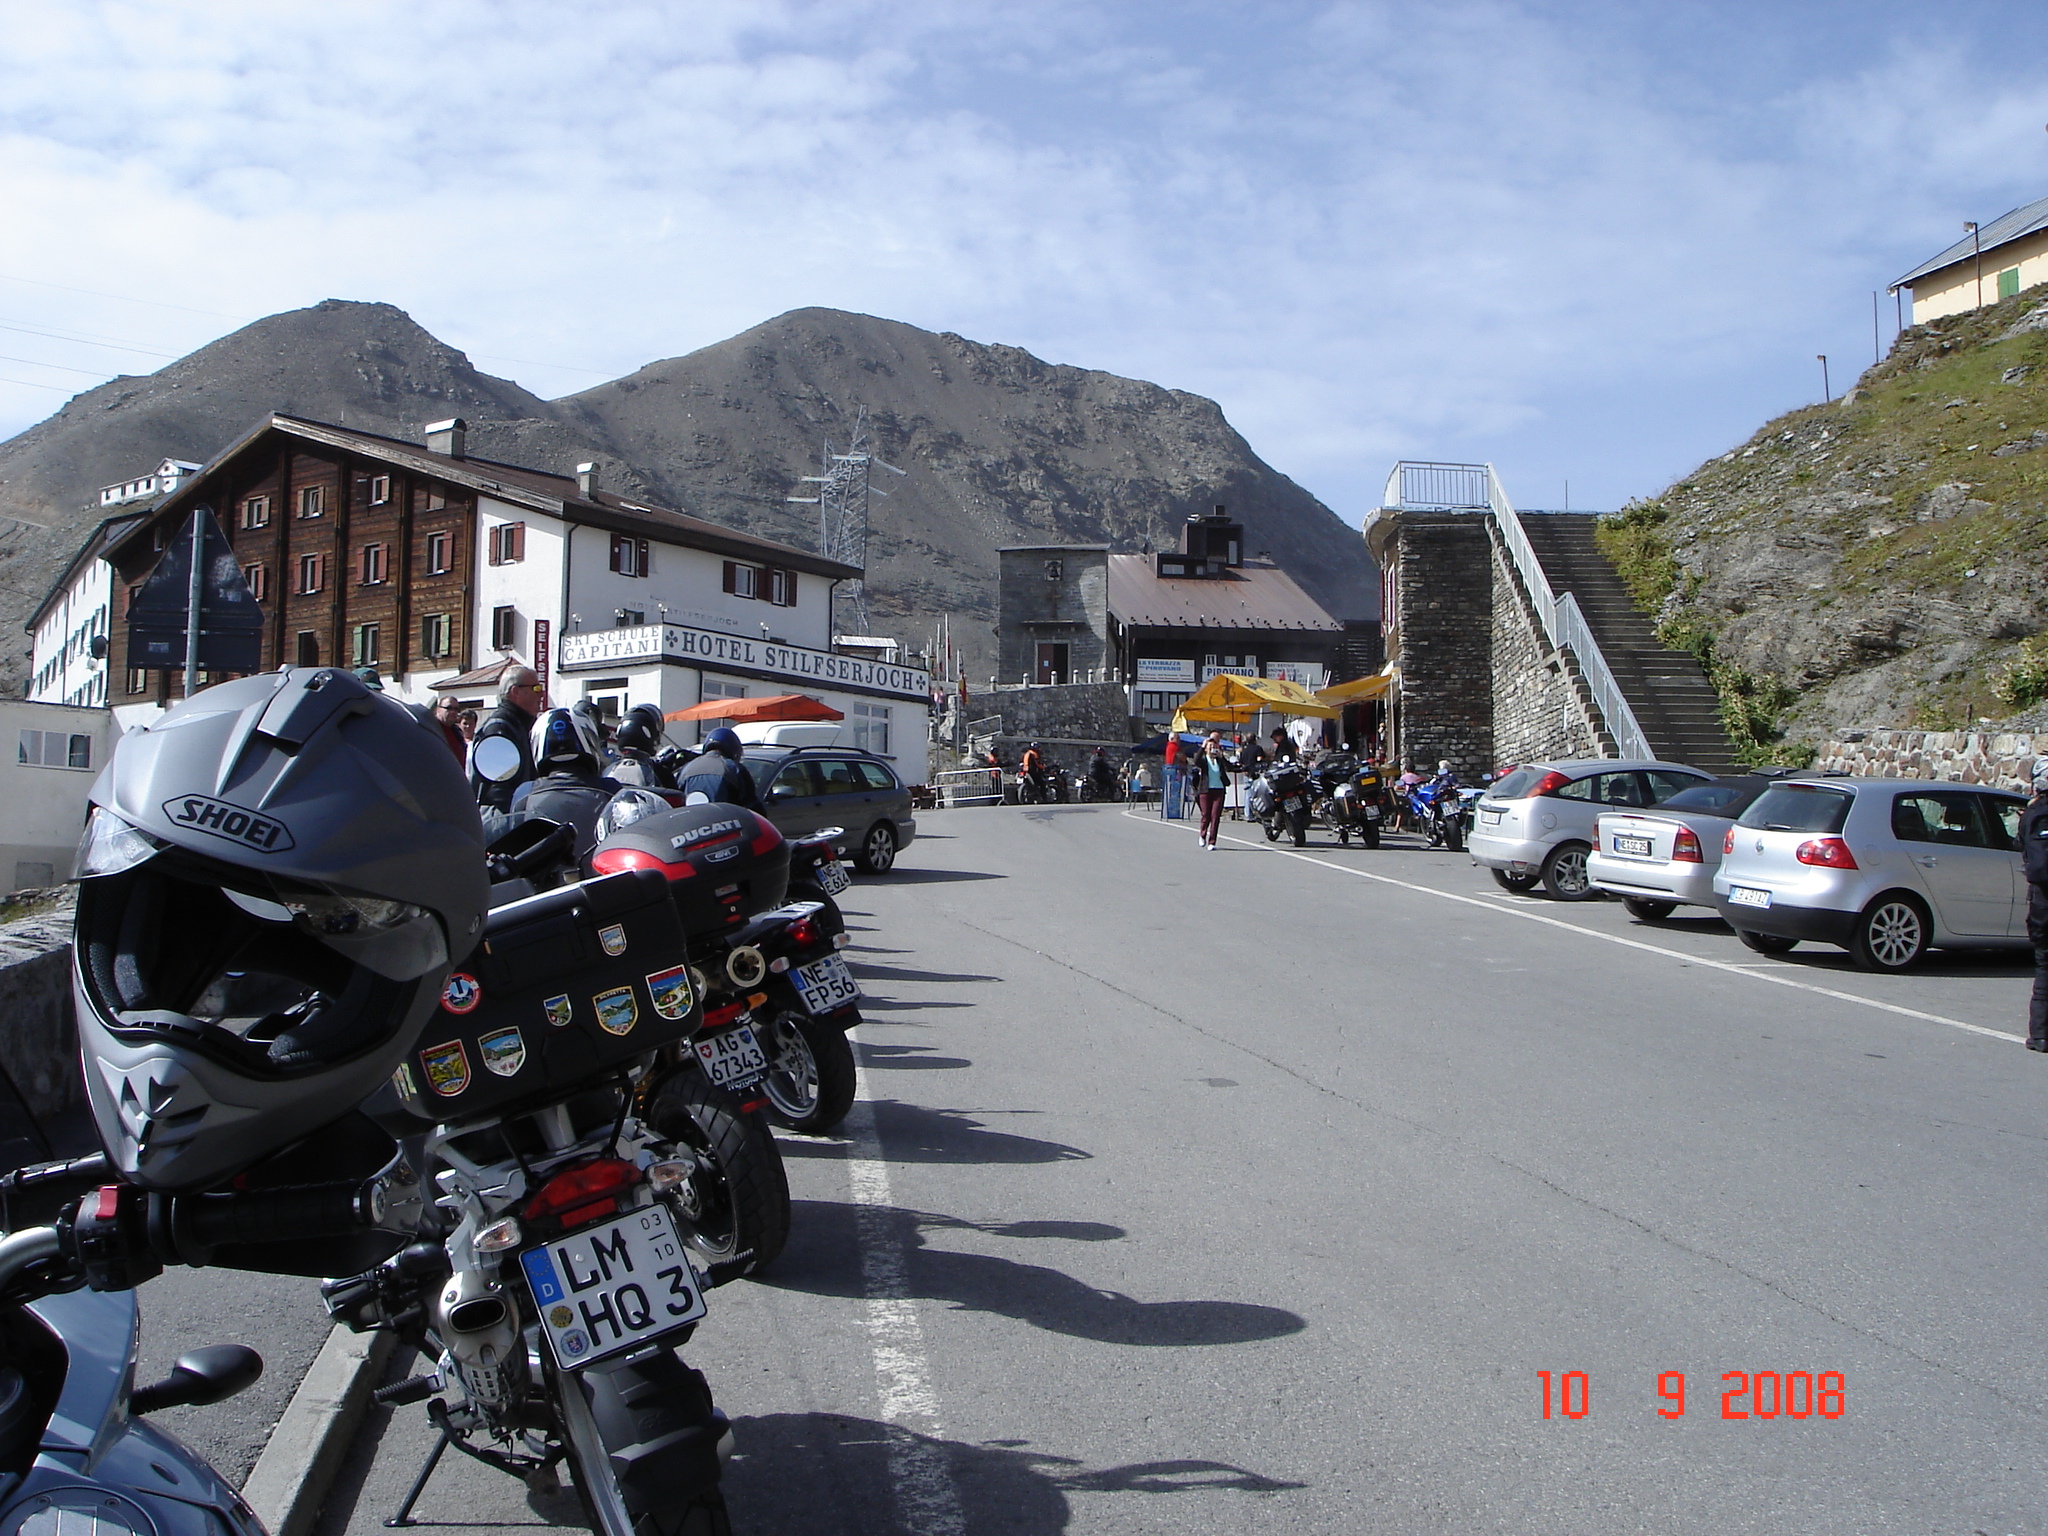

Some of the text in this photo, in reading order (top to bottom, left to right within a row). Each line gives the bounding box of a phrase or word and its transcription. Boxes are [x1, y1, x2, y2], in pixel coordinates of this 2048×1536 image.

[565, 626, 660, 647] SKI SCHULE
[565, 638, 660, 661] CAPITANI
[682, 631, 914, 691] HOTEL STILFSERJOCH
[176, 799, 282, 849] SHOEI
[670, 819, 742, 849] DUCATI
[822, 865, 837, 877] NE
[800, 962, 829, 987] NE
[805, 985, 829, 1010] FP
[829, 976, 855, 999] 56
[716, 1033, 739, 1057] AG
[712, 1048, 764, 1082] 67343
[557, 1213, 662, 1294] LM 03
[654, 1243, 675, 1261] 10
[541, 1283, 555, 1298] D
[577, 1265, 694, 1347] HQ 3
